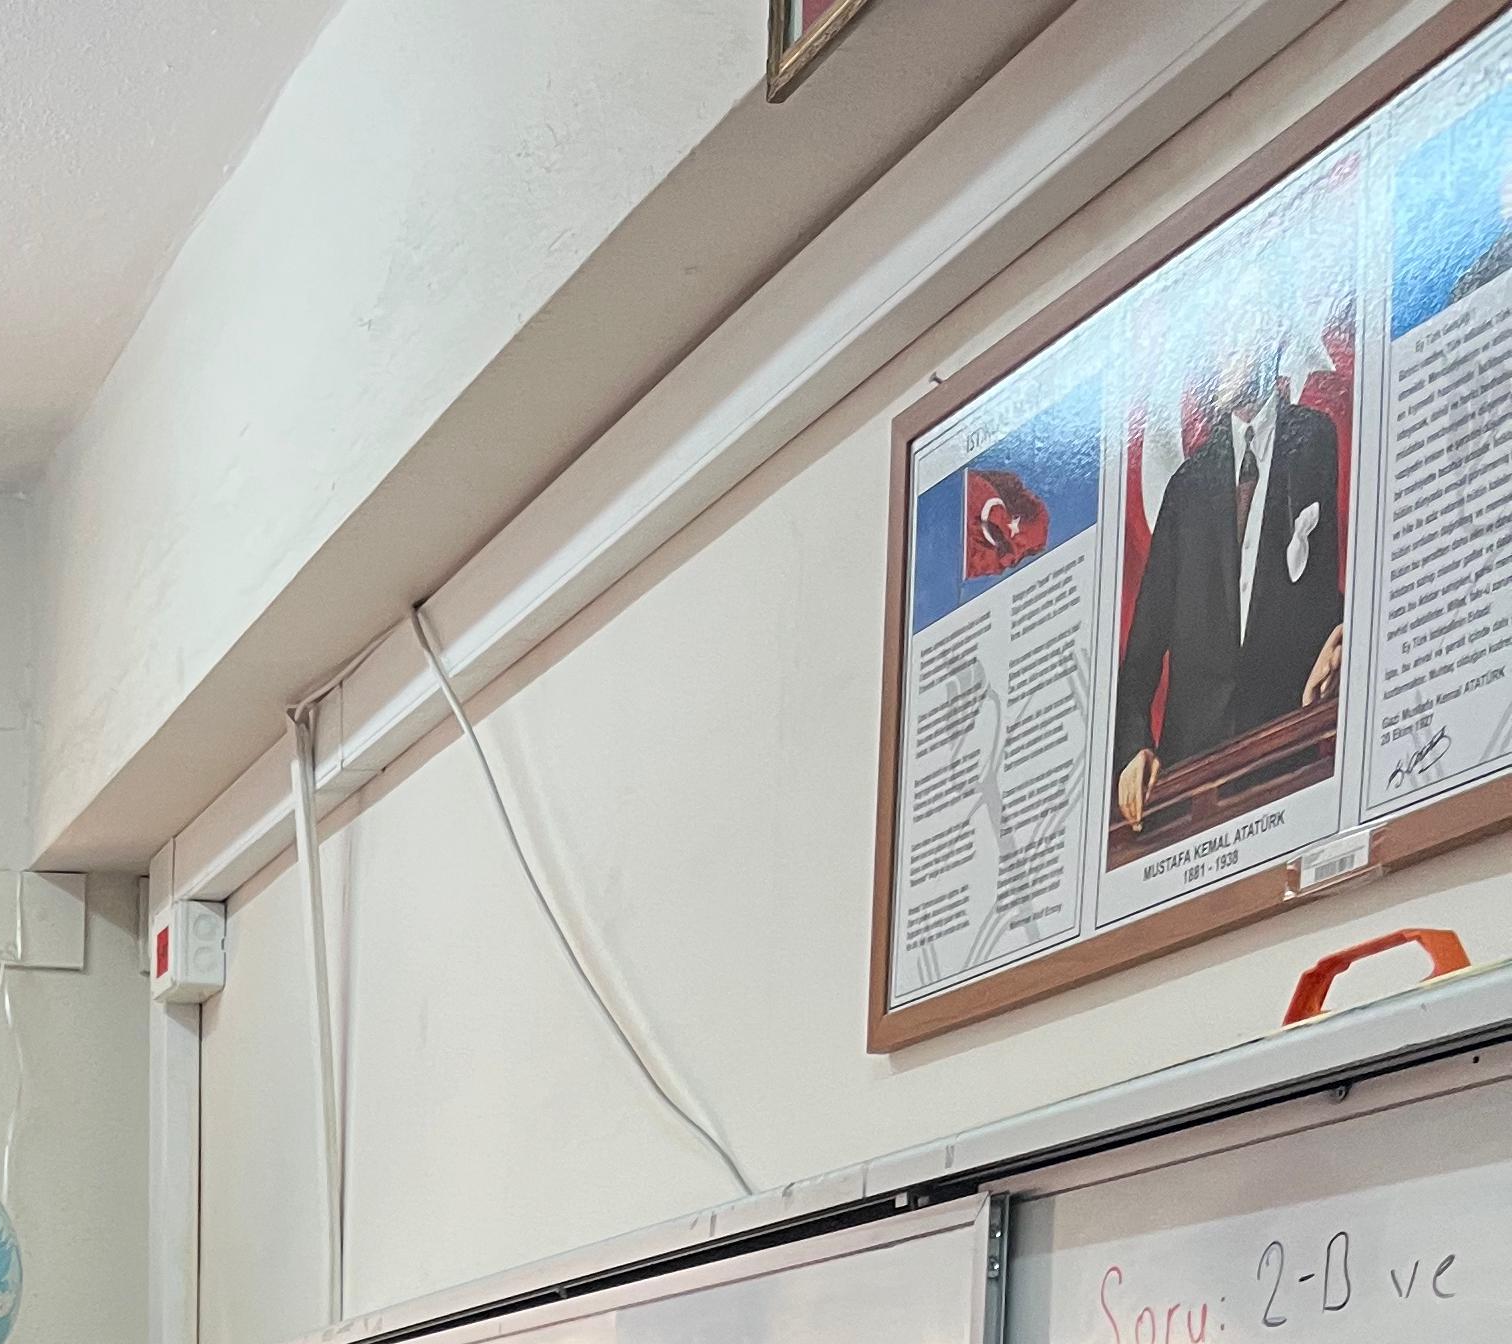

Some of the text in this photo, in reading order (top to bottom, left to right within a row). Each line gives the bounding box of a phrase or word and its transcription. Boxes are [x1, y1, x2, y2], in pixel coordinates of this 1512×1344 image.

[1142, 809, 1286, 882] MUSTAFA KEMAL ATATÜRK
[1183, 865, 1206, 884] 1881
[1215, 850, 1239, 873] 1938
[1390, 1253, 1455, 1299] ve
